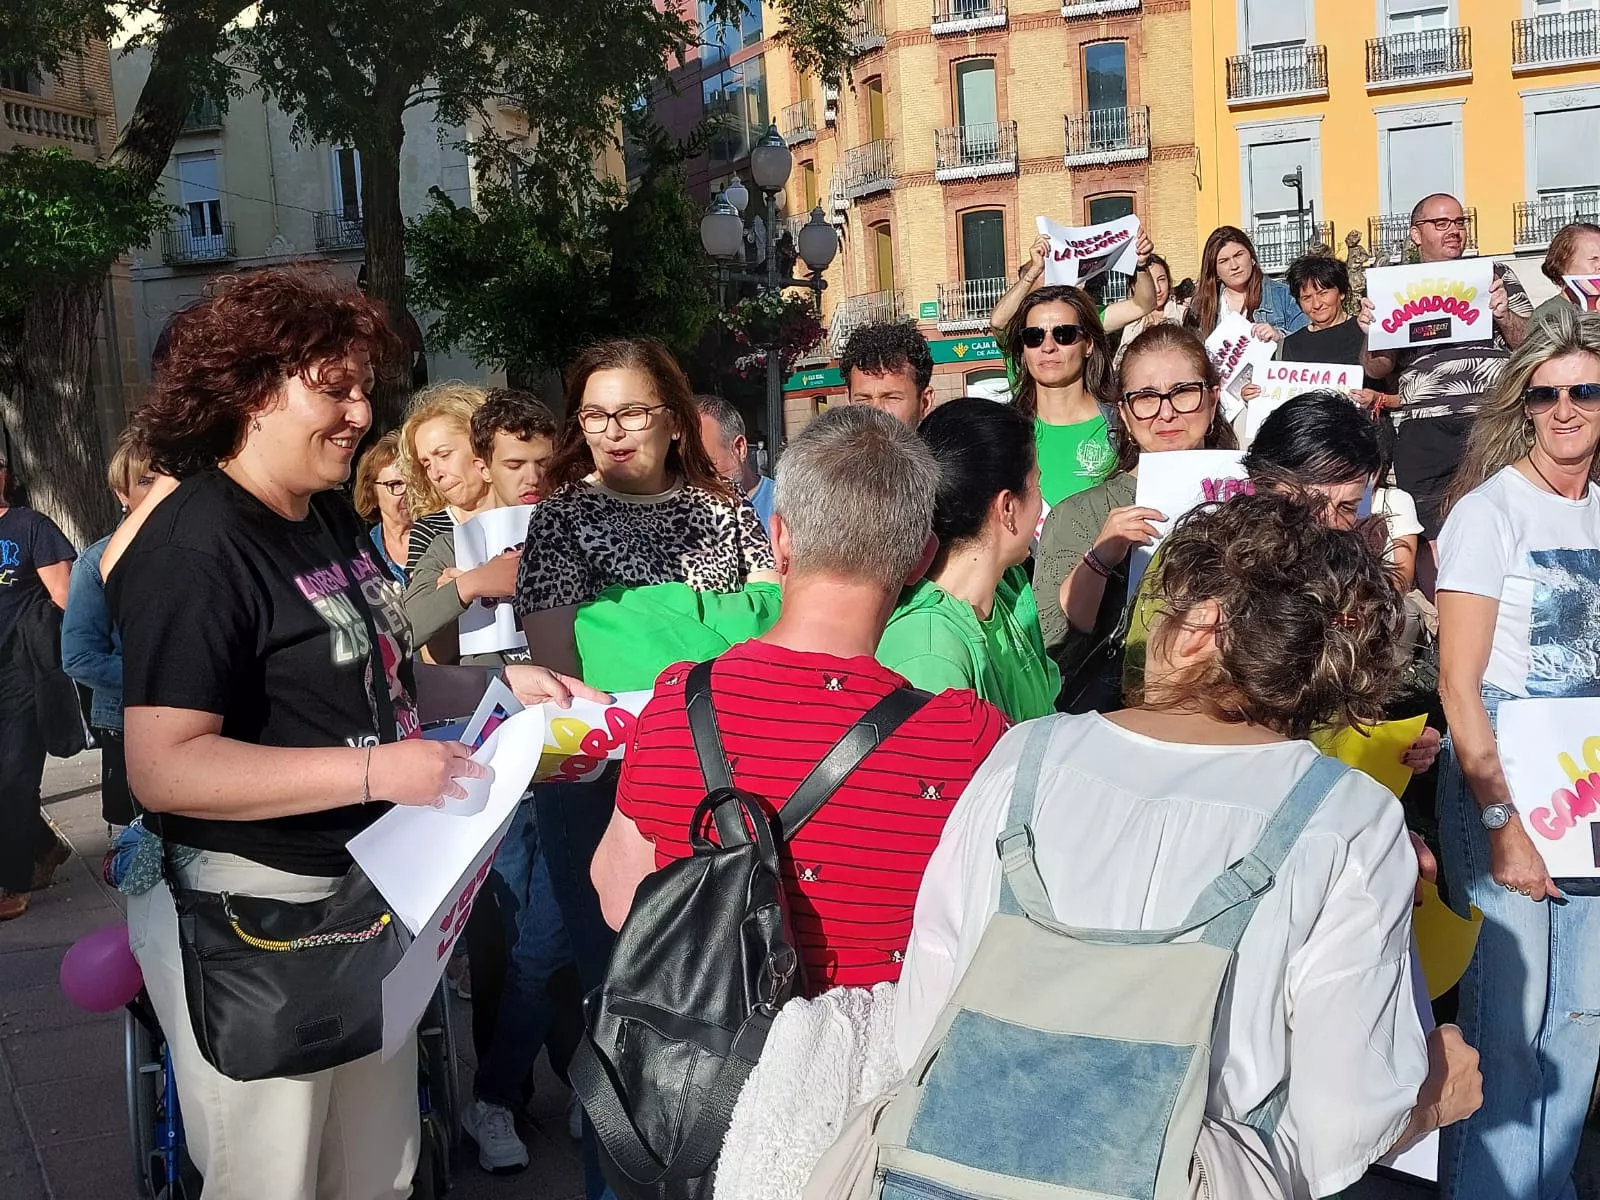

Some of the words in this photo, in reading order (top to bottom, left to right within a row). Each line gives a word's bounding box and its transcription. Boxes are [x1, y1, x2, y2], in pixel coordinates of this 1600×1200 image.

[1064, 230, 1113, 248] LORENA
[1054, 248, 1072, 262] LA
[1393, 278, 1478, 307] LORENA
[1381, 295, 1480, 334] GANADORA
[971, 341, 991, 350] CAJA
[1267, 367, 1331, 385] LORENA
[1337, 371, 1348, 385] A
